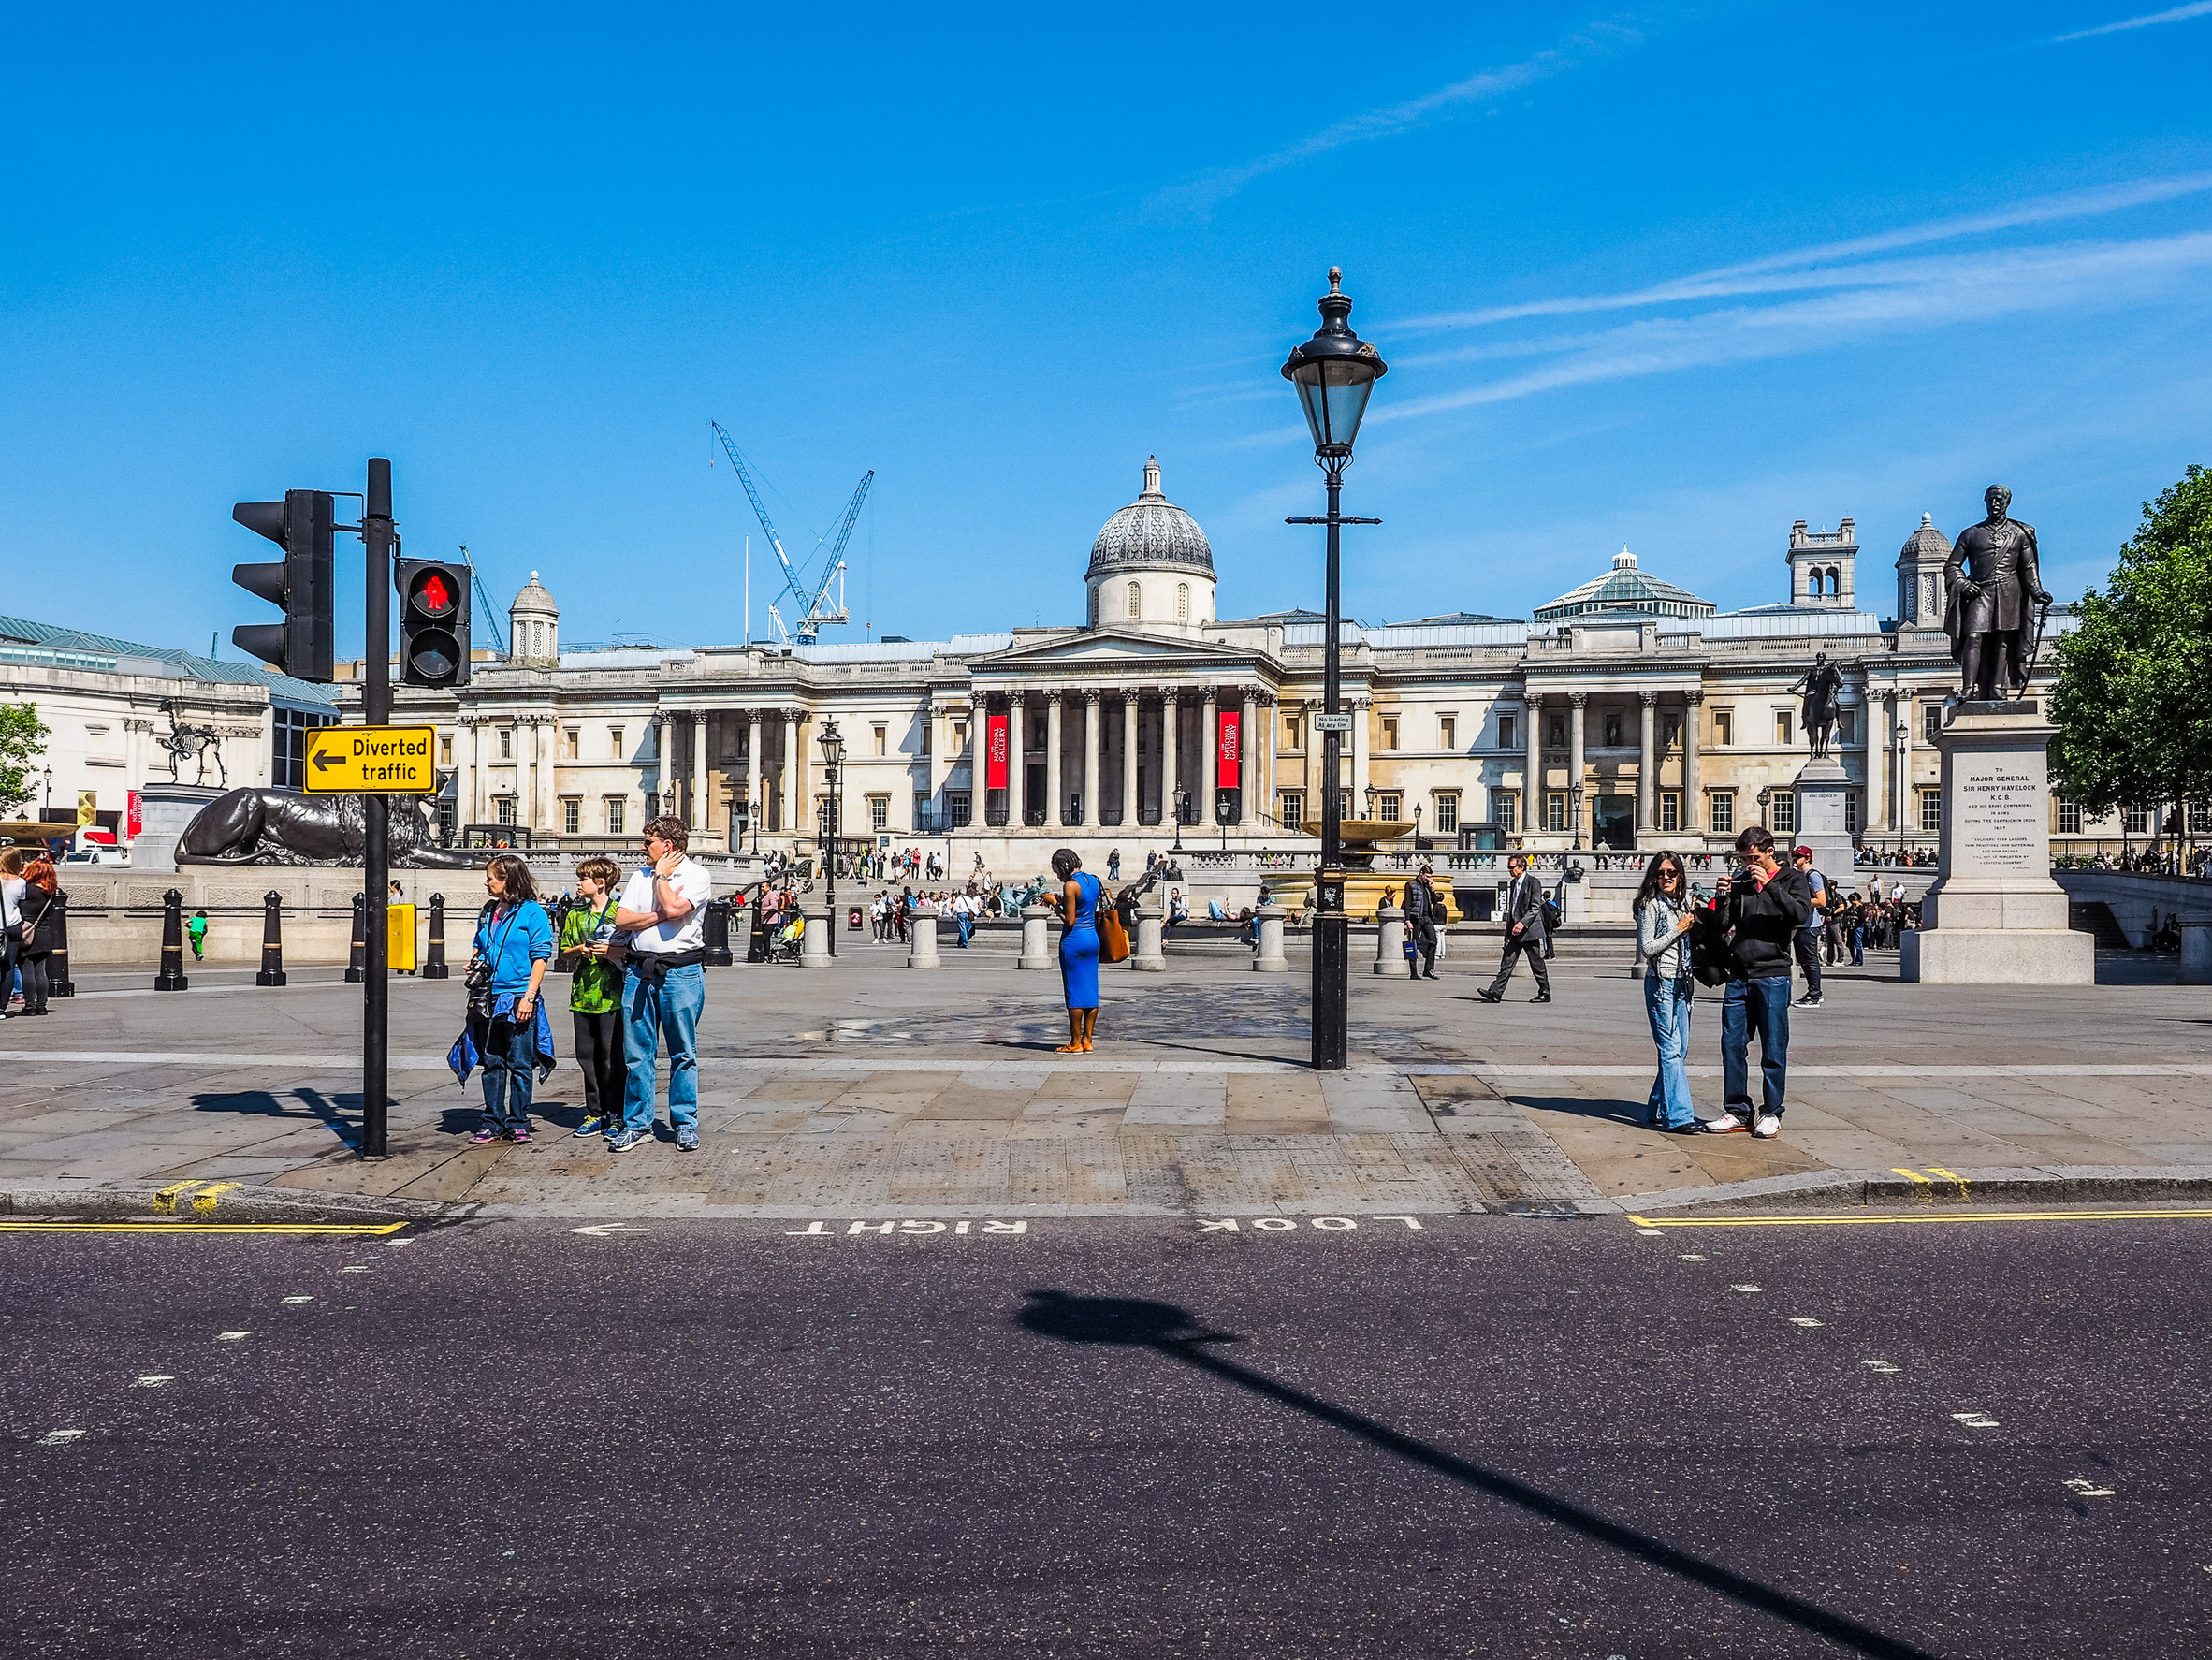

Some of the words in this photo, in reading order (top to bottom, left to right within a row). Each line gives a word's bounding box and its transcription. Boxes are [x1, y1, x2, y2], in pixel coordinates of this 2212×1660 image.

[353, 737, 427, 756] Diverted
[361, 763, 417, 780] traffic
[785, 1219, 1028, 1235] RIGHT
[1195, 1216, 1425, 1232] LOOK
